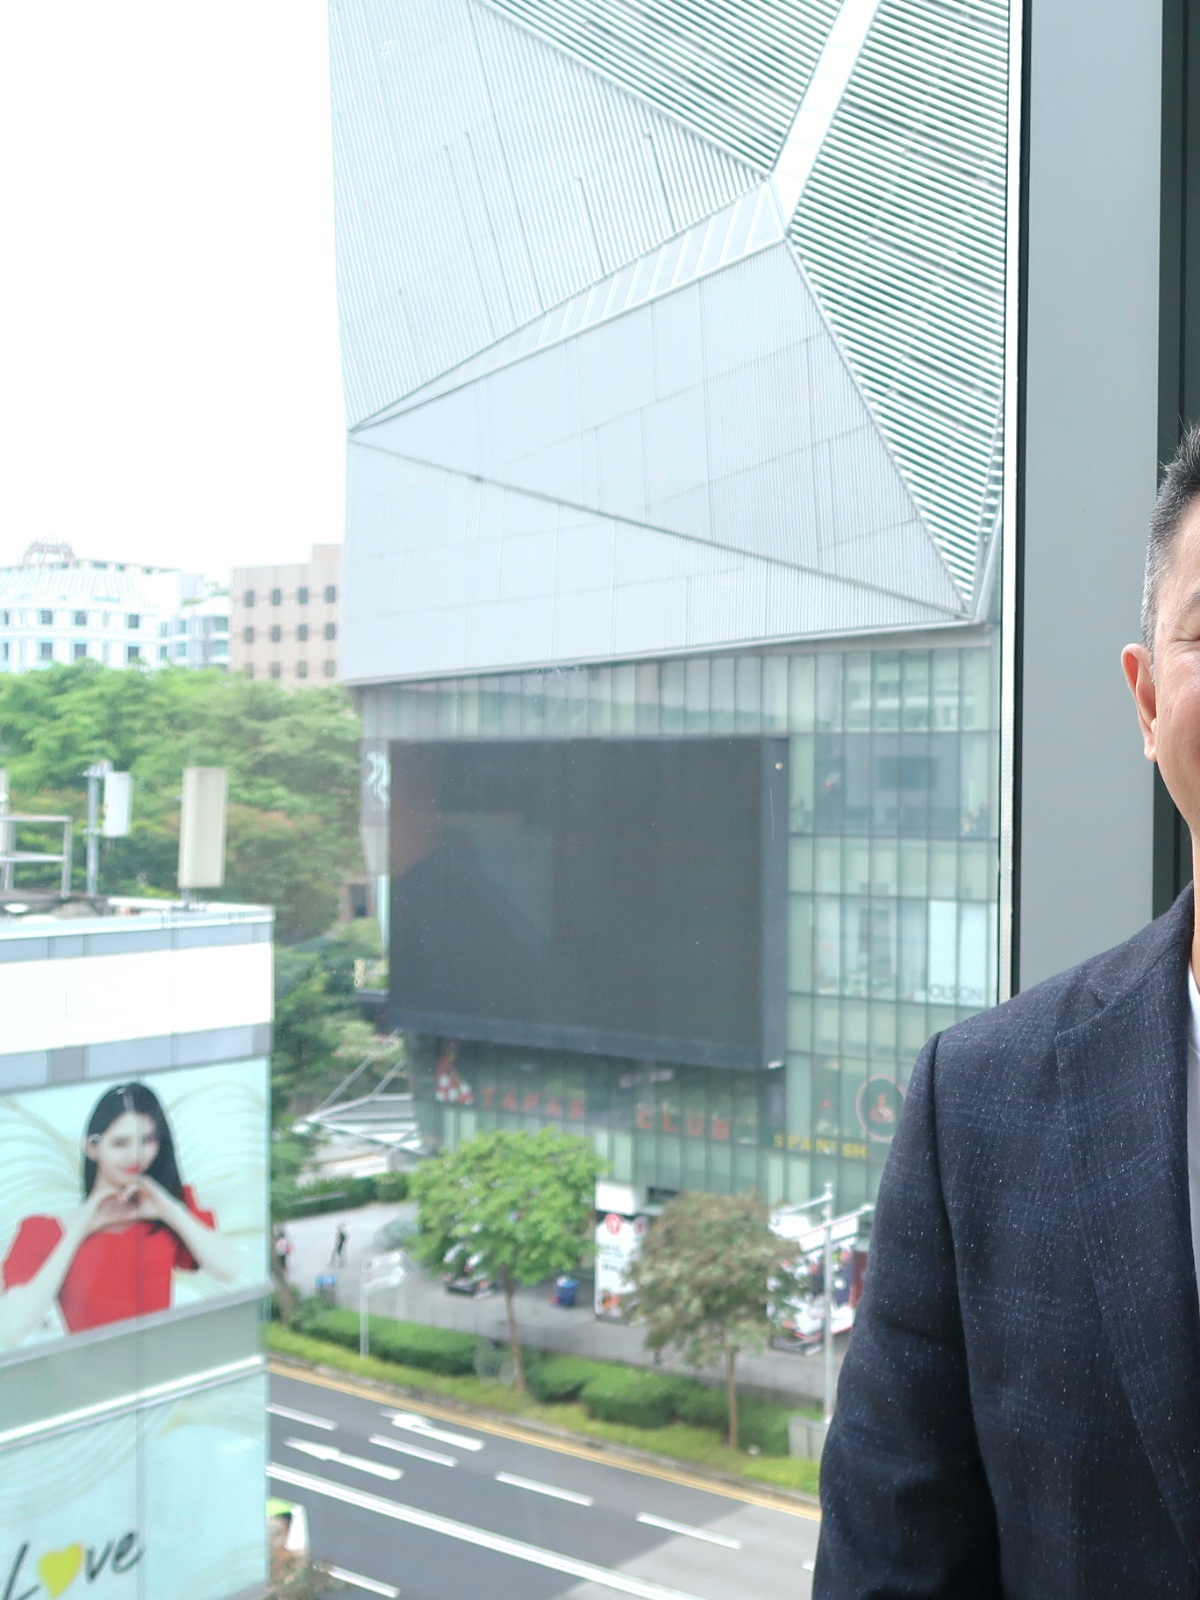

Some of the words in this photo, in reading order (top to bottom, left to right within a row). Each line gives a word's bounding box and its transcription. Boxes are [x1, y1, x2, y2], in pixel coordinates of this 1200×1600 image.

[480, 1087, 583, 1119] TAPAS
[636, 1108, 730, 1141] CLUB
[773, 1134, 868, 1159] SPANISH
